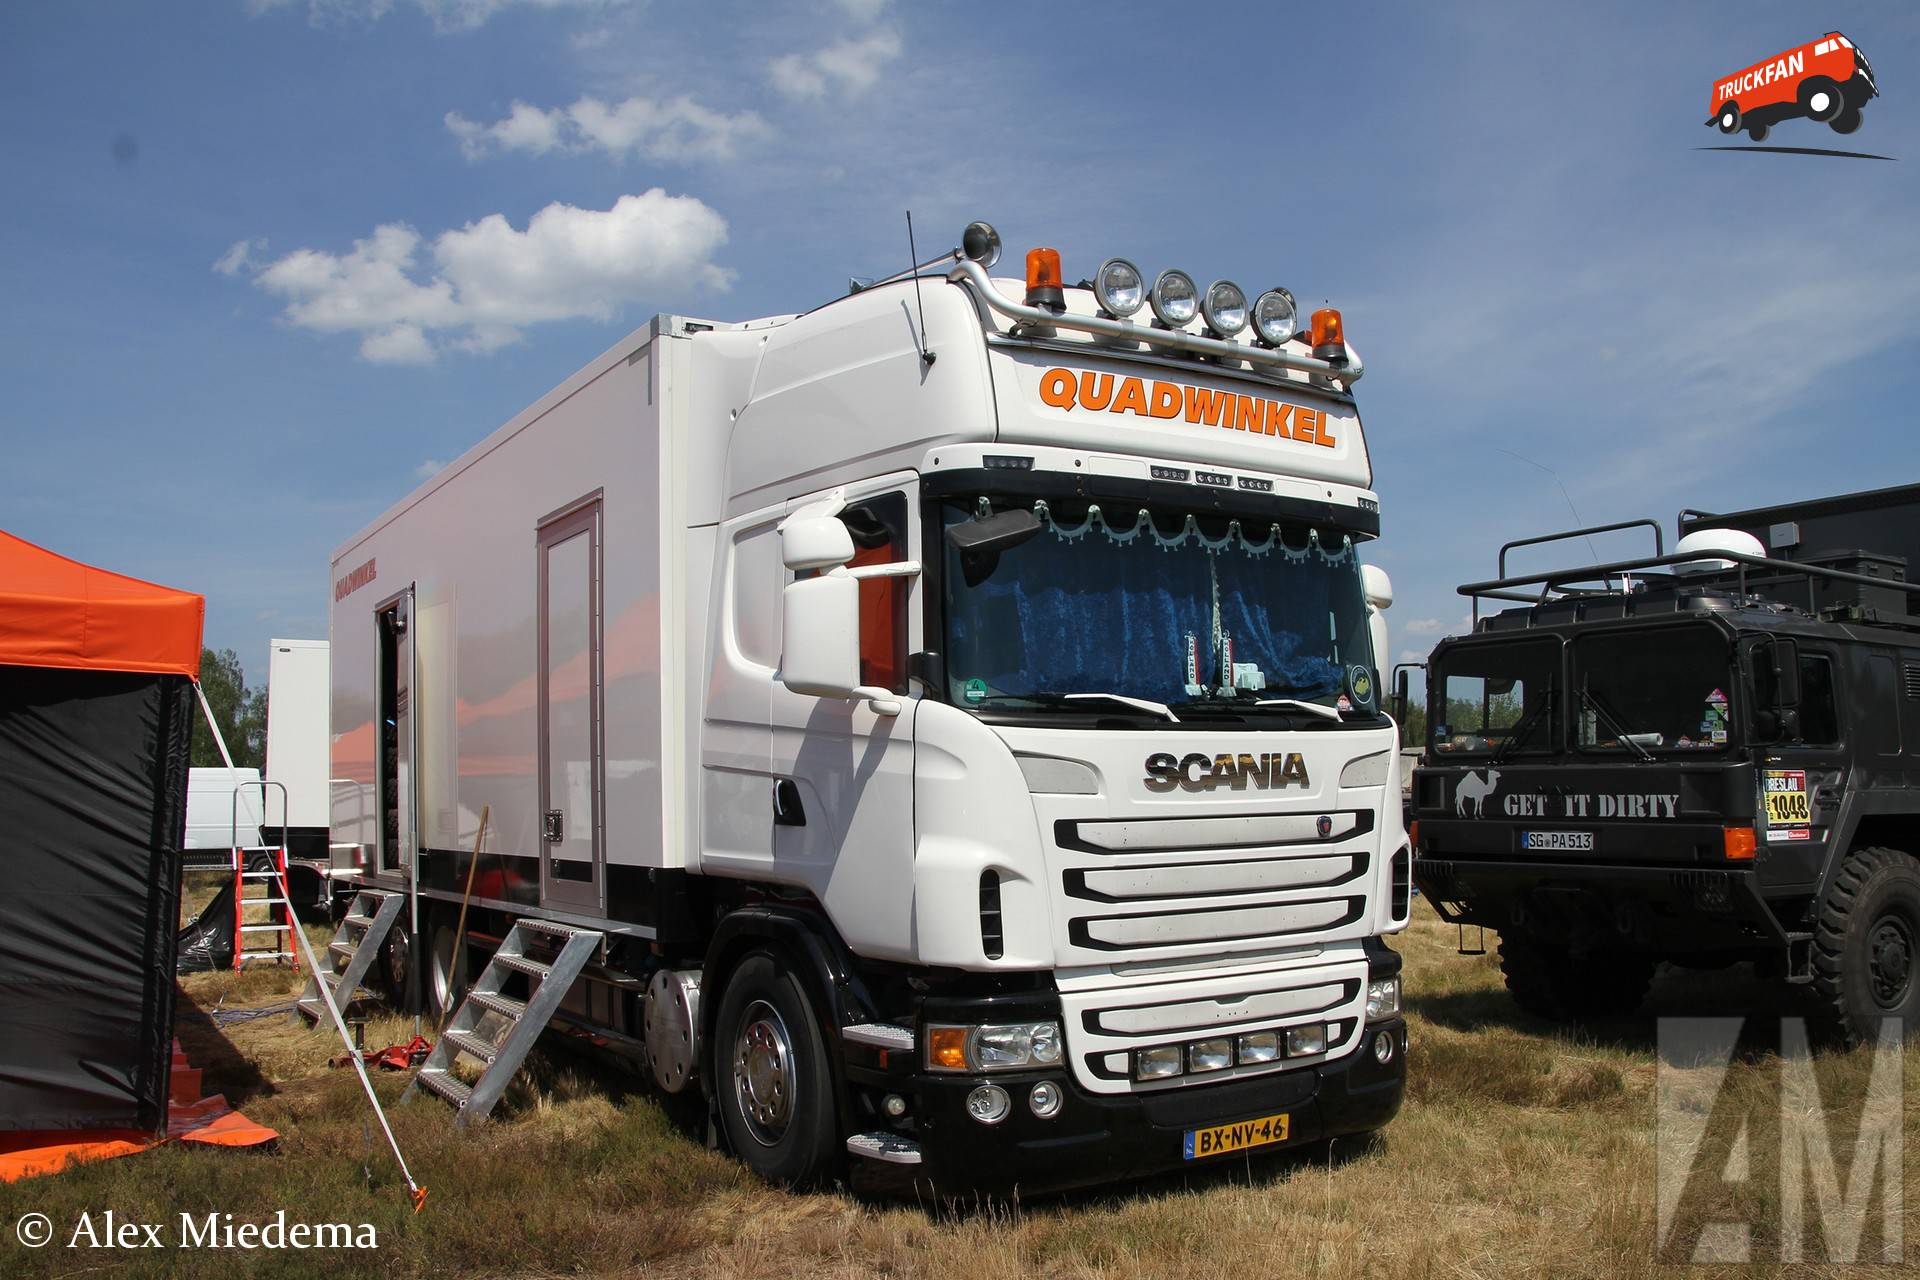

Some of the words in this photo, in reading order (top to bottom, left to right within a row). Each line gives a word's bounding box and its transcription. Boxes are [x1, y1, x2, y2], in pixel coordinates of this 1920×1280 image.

[1039, 367, 1336, 448] QUADWINKEL
[1143, 752, 1310, 793] SCANIA
[1503, 794, 1548, 816] GET
[1564, 794, 1591, 817] IT
[1598, 794, 1680, 818] DIRTY
[1771, 795, 1808, 820] 1048
[1529, 834, 1544, 848] SG
[1200, 1118, 1284, 1154] BX-NV-46
